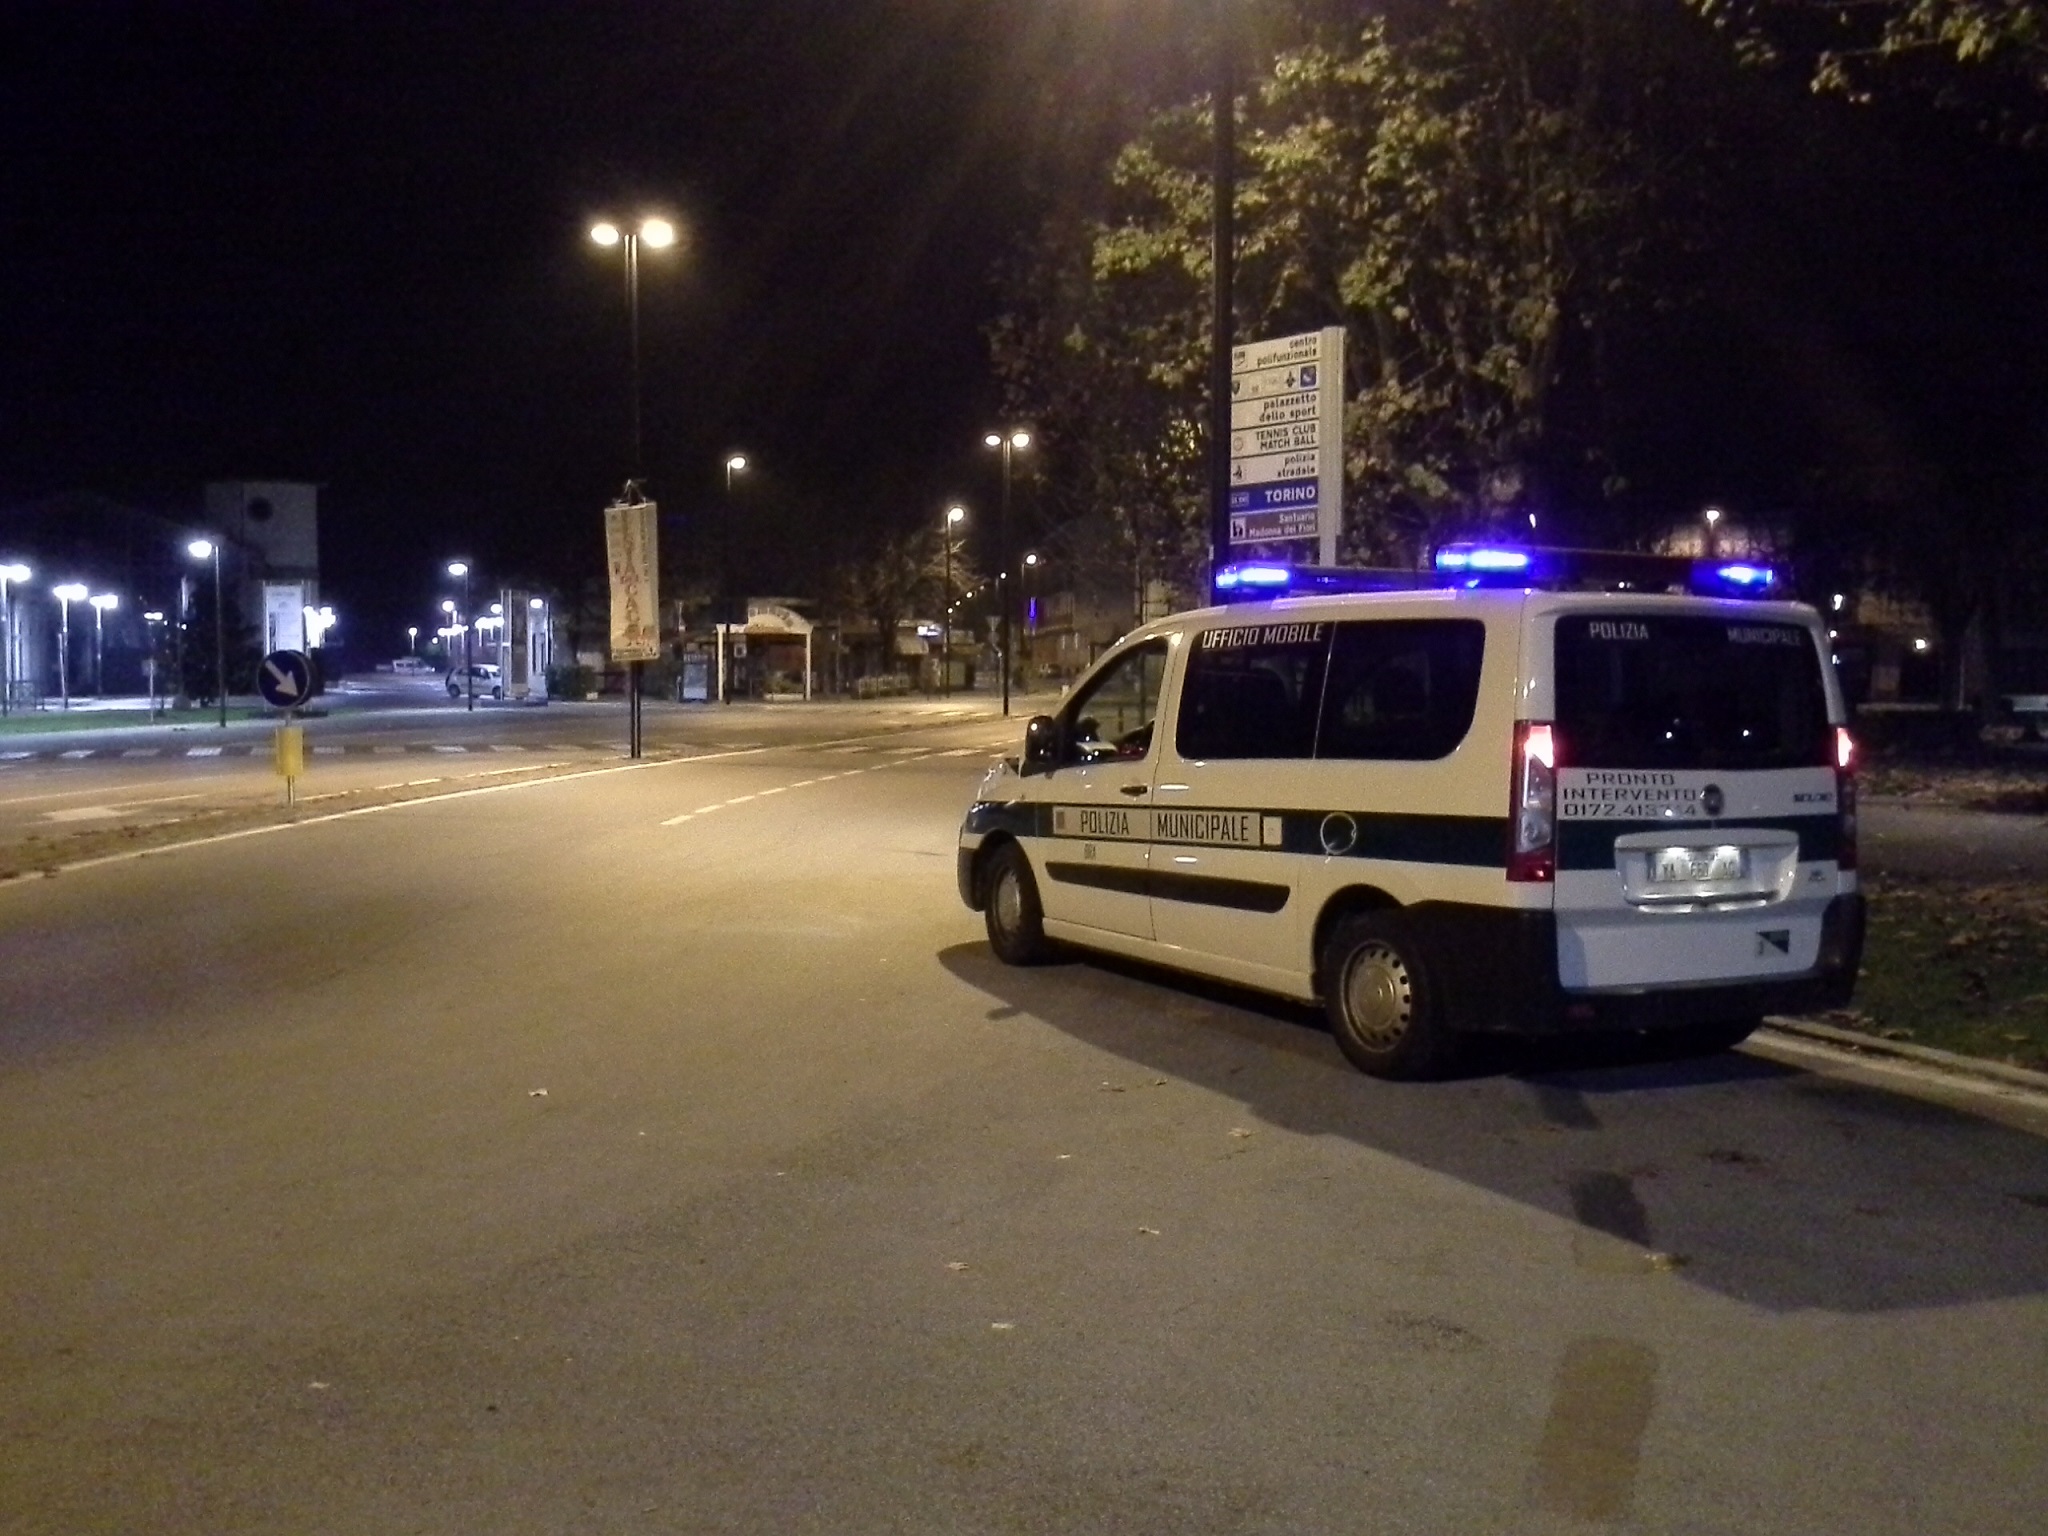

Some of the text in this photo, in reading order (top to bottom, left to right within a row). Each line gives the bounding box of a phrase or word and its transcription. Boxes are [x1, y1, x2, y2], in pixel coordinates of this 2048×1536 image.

[1289, 336, 1317, 349] centro
[1257, 347, 1317, 368] polifunzionale
[1263, 393, 1317, 412] palazzetto
[1260, 405, 1316, 422] dello sport
[1256, 423, 1316, 441] TENNIS CLUB
[1260, 434, 1316, 451] MATCH BALL
[1284, 453, 1315, 467] polizia
[1277, 465, 1316, 478] stradale
[1265, 485, 1316, 503] TORINO
[1202, 623, 1324, 648] UFFICIO MOBILE
[1588, 621, 1801, 646] POLIZIA MUNICIPALE
[1586, 772, 1675, 785] PRONTO
[1563, 788, 1696, 801] INTERVENTO
[1080, 810, 1249, 842] POLIZIA MUNICIPALE
